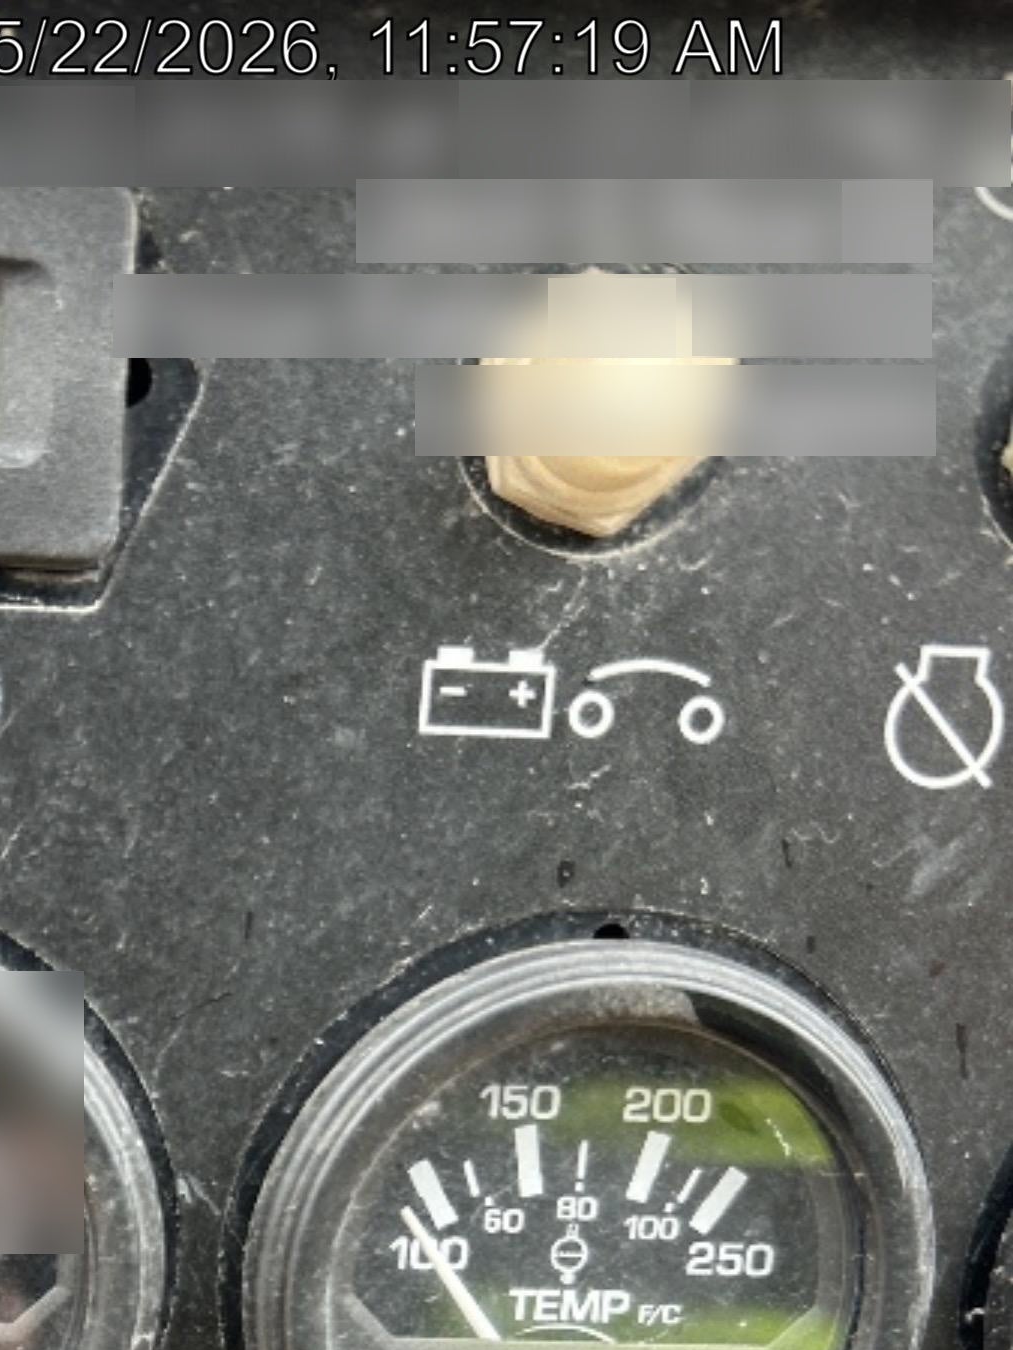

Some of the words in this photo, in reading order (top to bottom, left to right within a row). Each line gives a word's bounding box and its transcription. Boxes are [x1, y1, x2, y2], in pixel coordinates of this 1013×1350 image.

[480, 1083, 562, 1121] 150
[622, 1086, 713, 1124] 200
[482, 1207, 526, 1235] 60
[555, 1195, 600, 1222] 80
[622, 1213, 682, 1242] 100
[685, 1241, 776, 1279] 250
[507, 1286, 632, 1324] TEMP
[636, 1302, 686, 1328] F/C
